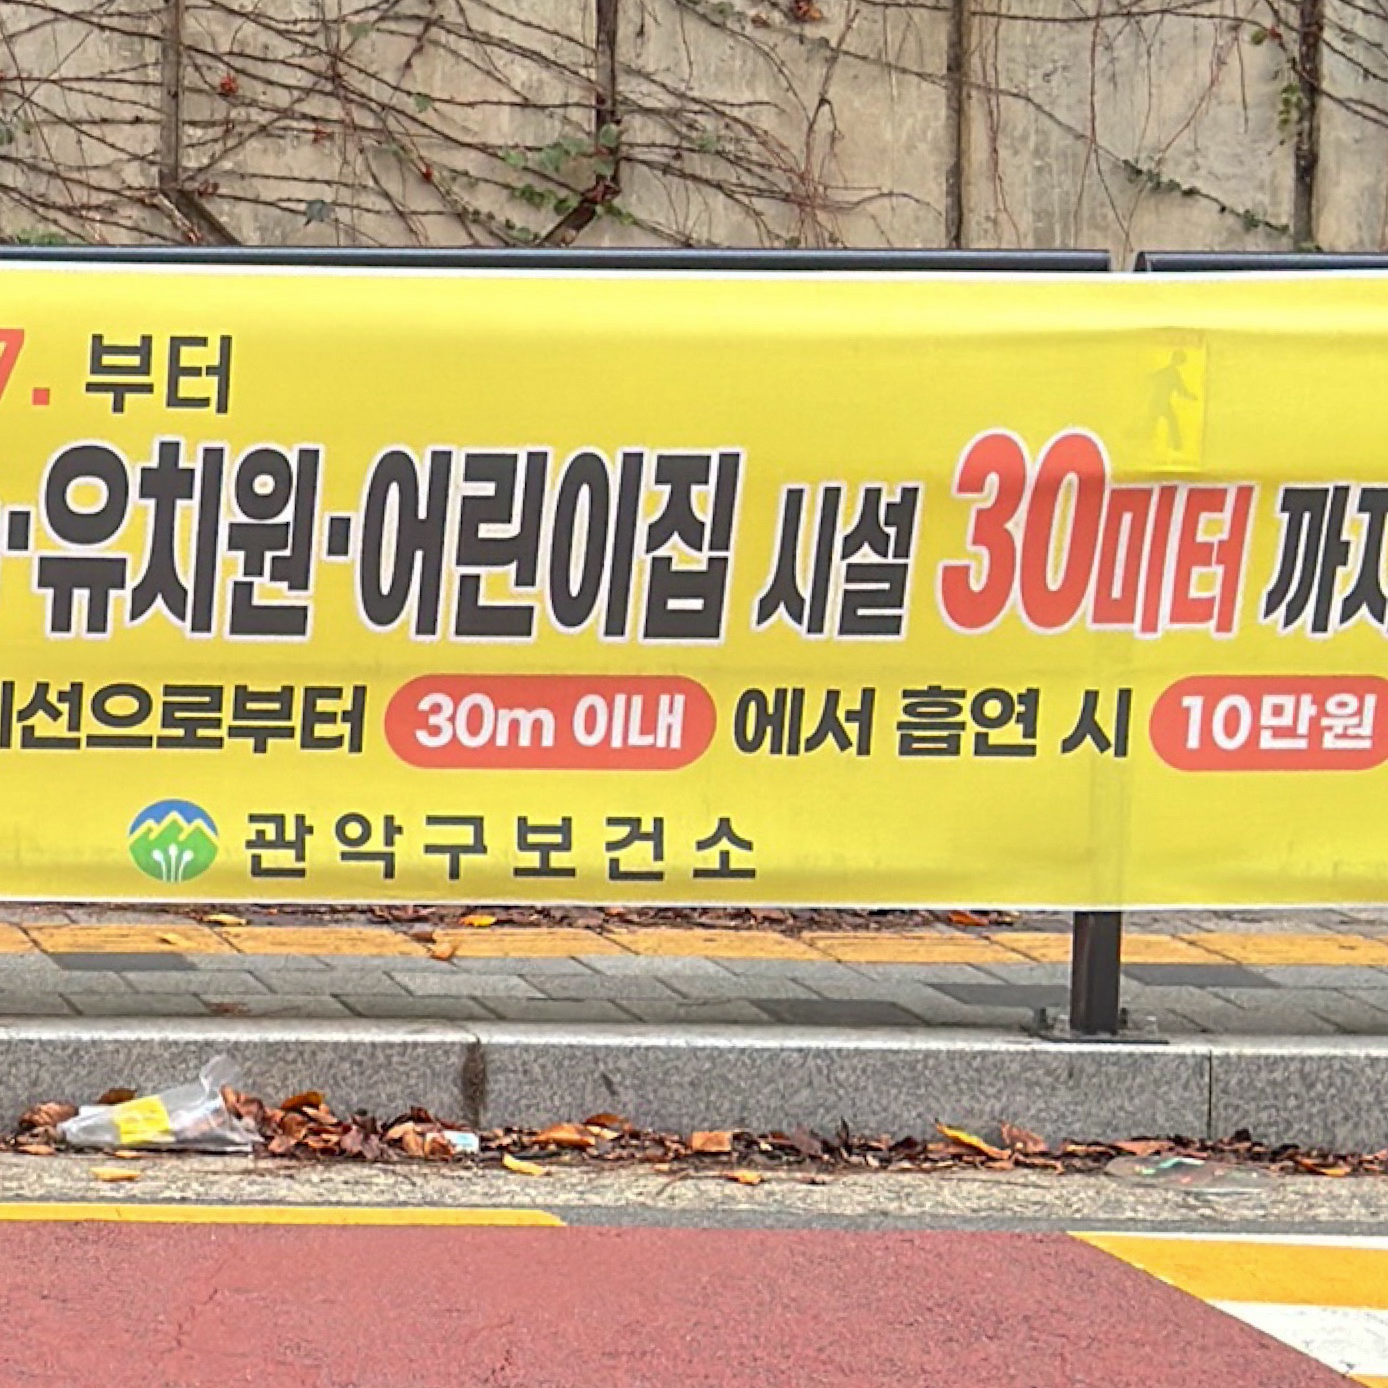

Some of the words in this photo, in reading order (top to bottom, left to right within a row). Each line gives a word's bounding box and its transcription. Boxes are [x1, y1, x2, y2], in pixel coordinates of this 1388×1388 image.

[84, 332, 232, 415] 부터
[756, 486, 922, 636] 시설
[940, 432, 1254, 635] 30미터
[414, 692, 555, 749] 30m
[572, 693, 684, 750] 이내
[733, 686, 876, 757] 에서
[895, 684, 1041, 758] 흡연
[1060, 686, 1133, 758] 시
[1181, 692, 1378, 751] 10만원
[244, 811, 758, 882] 관악구보건소
